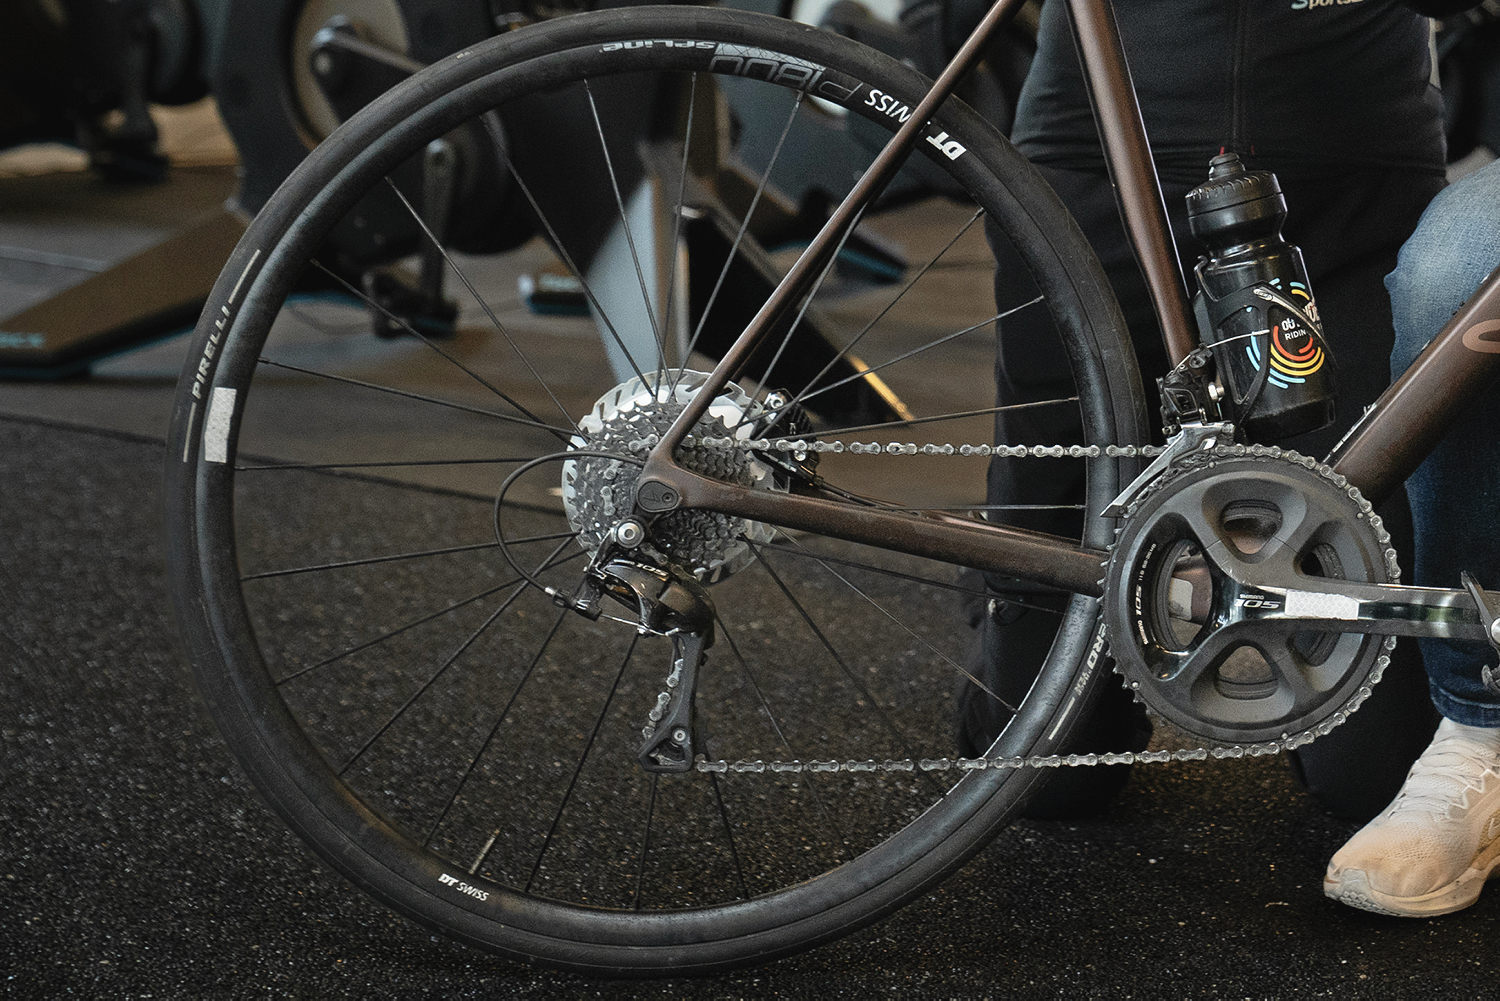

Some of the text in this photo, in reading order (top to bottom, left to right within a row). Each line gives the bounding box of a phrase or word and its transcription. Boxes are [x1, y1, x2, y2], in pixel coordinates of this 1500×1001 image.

[926, 131, 967, 161] DT
[191, 305, 231, 400] PIRELLI
[636, 563, 669, 577] 105
[1234, 599, 1282, 609] 105
[437, 873, 490, 902] DT SWISS
